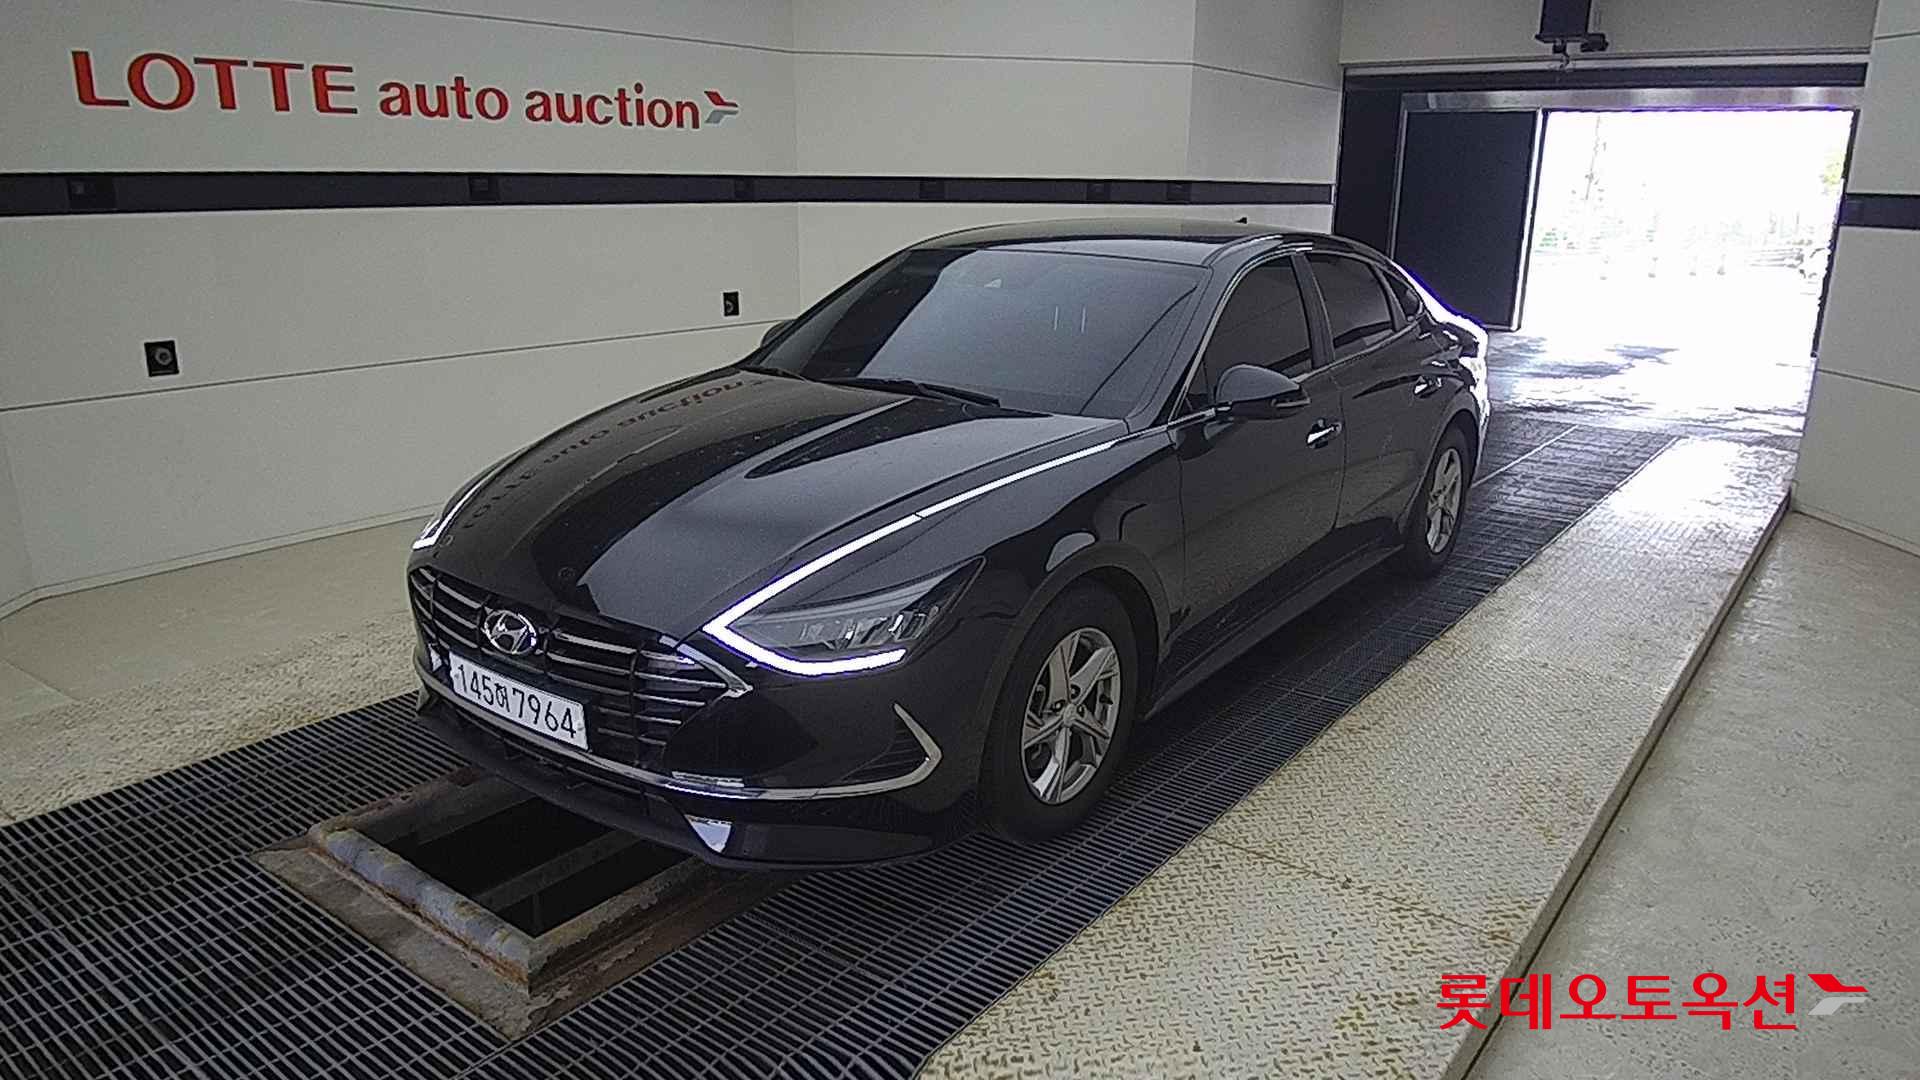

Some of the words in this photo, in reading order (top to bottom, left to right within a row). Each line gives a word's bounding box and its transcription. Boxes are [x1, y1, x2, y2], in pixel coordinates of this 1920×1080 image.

[72, 51, 358, 115] LOTTE
[379, 78, 509, 121] auto
[525, 83, 700, 130] auction
